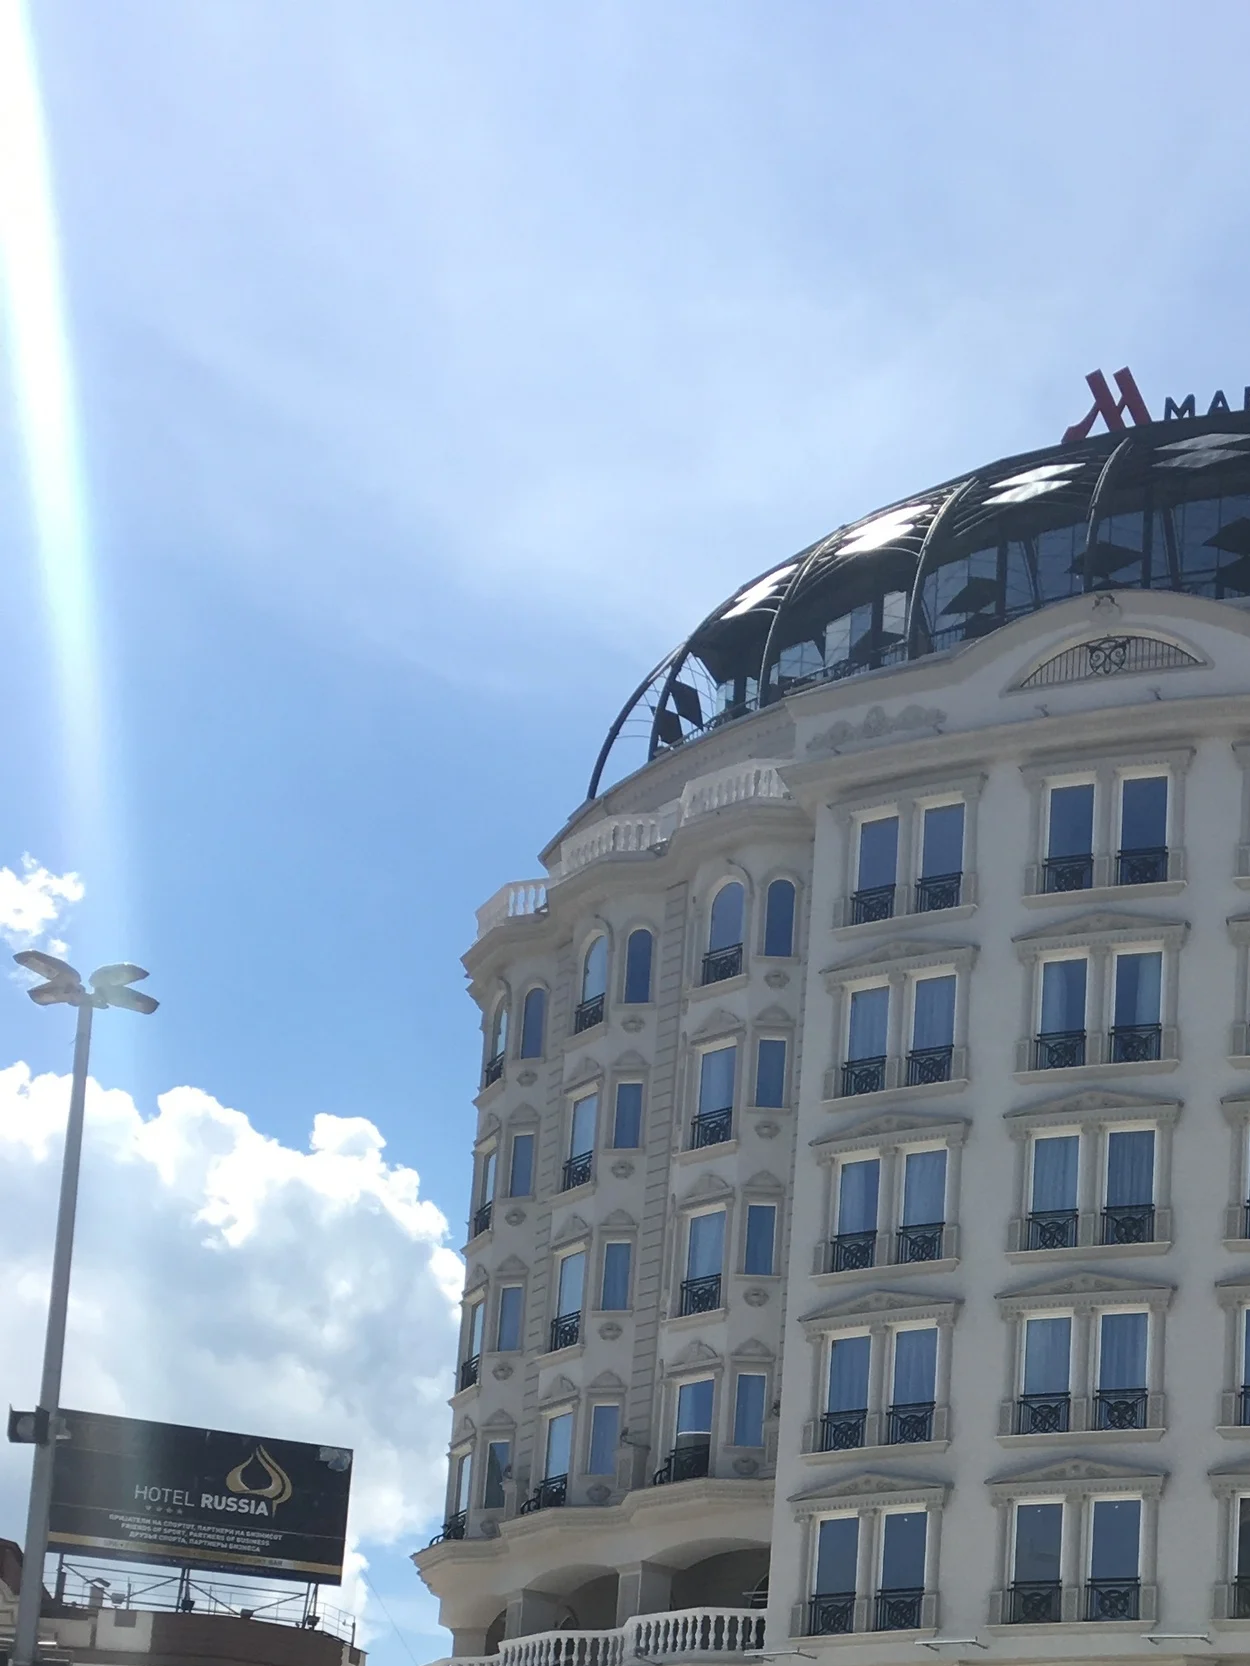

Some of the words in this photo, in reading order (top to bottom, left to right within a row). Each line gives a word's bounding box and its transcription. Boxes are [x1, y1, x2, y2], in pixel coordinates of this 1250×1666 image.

[134, 1484, 195, 1507] HOTEL
[200, 1493, 269, 1517] RUSSIA
[121, 1522, 152, 1533] FRIENDS
[189, 1531, 225, 1542] PARTNERS
[236, 1537, 270, 1547] BUSINESS
